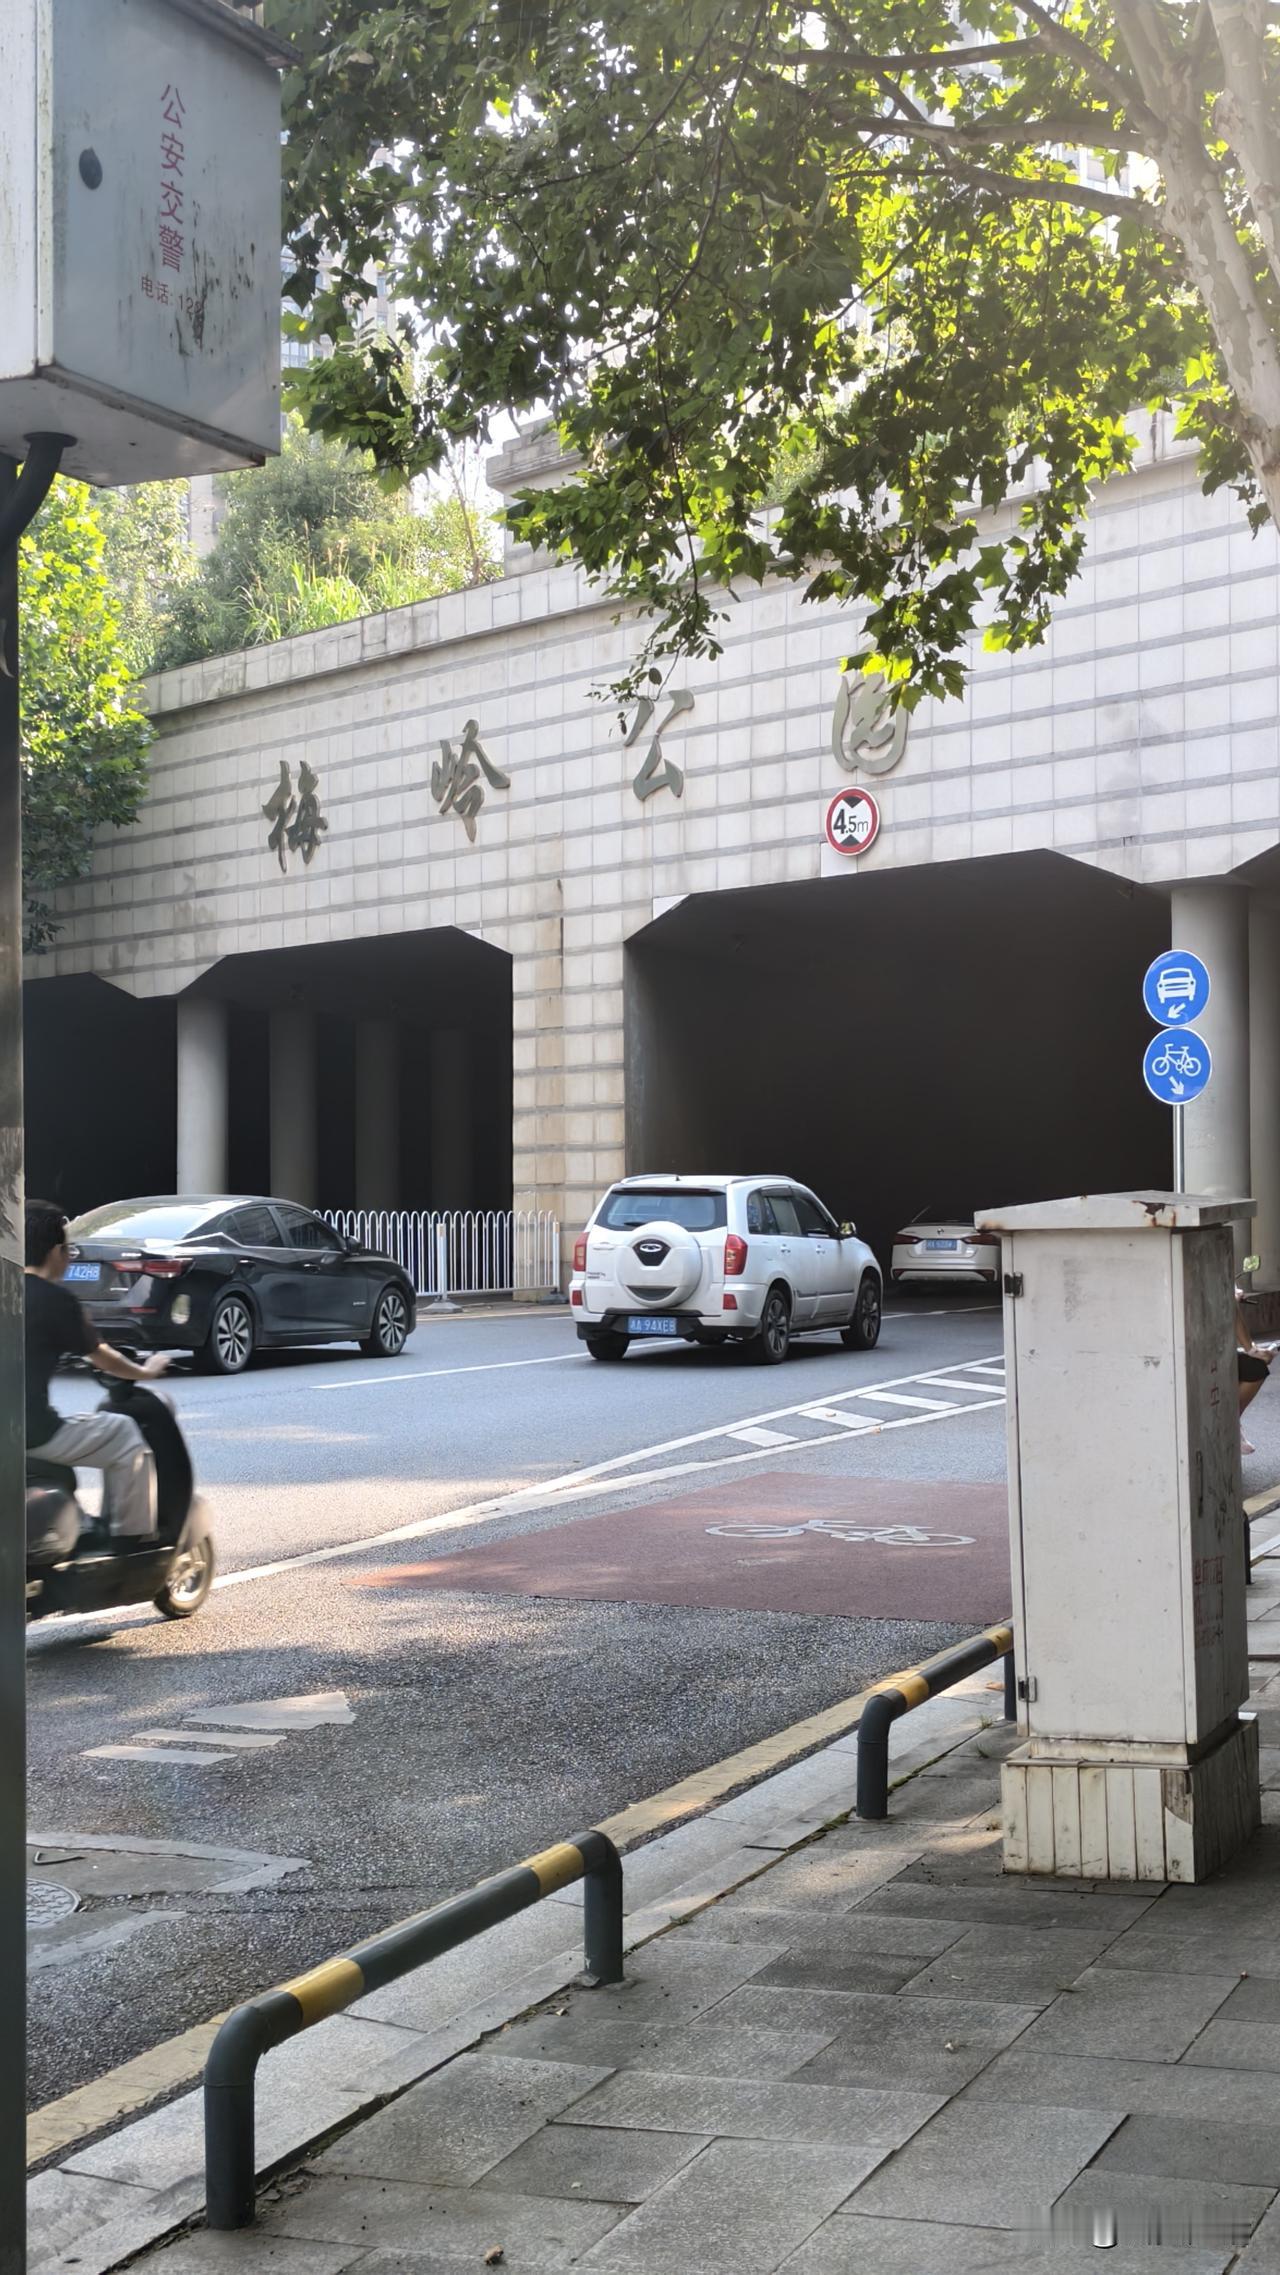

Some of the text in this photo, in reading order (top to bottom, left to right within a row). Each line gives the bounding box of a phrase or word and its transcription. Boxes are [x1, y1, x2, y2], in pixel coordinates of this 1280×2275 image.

[158, 84, 186, 272] 公安交警
[833, 808, 869, 834] 4.5m
